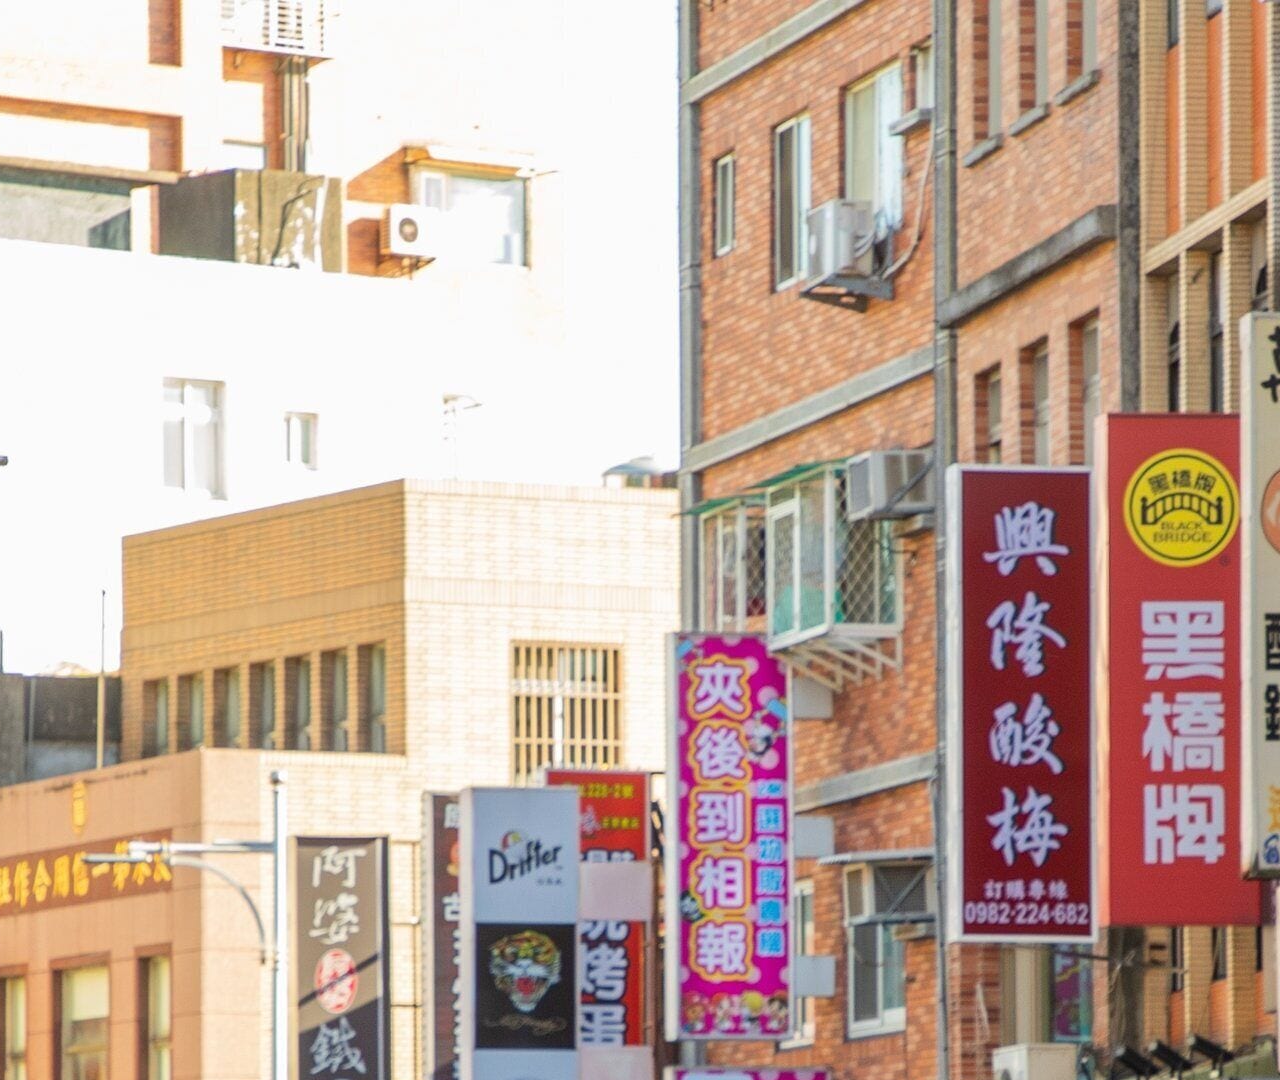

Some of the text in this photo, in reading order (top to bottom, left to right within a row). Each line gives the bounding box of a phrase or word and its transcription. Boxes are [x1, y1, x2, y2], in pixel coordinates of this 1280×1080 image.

[1149, 472, 1216, 494] 黑橋牌
[1153, 531, 1212, 544] BRIDGE
[1161, 521, 1203, 531] BLACK
[983, 502, 1070, 867] 興隆酸梅
[1140, 600, 1226, 865] 黑橋牌
[488, 840, 563, 886] Drifter
